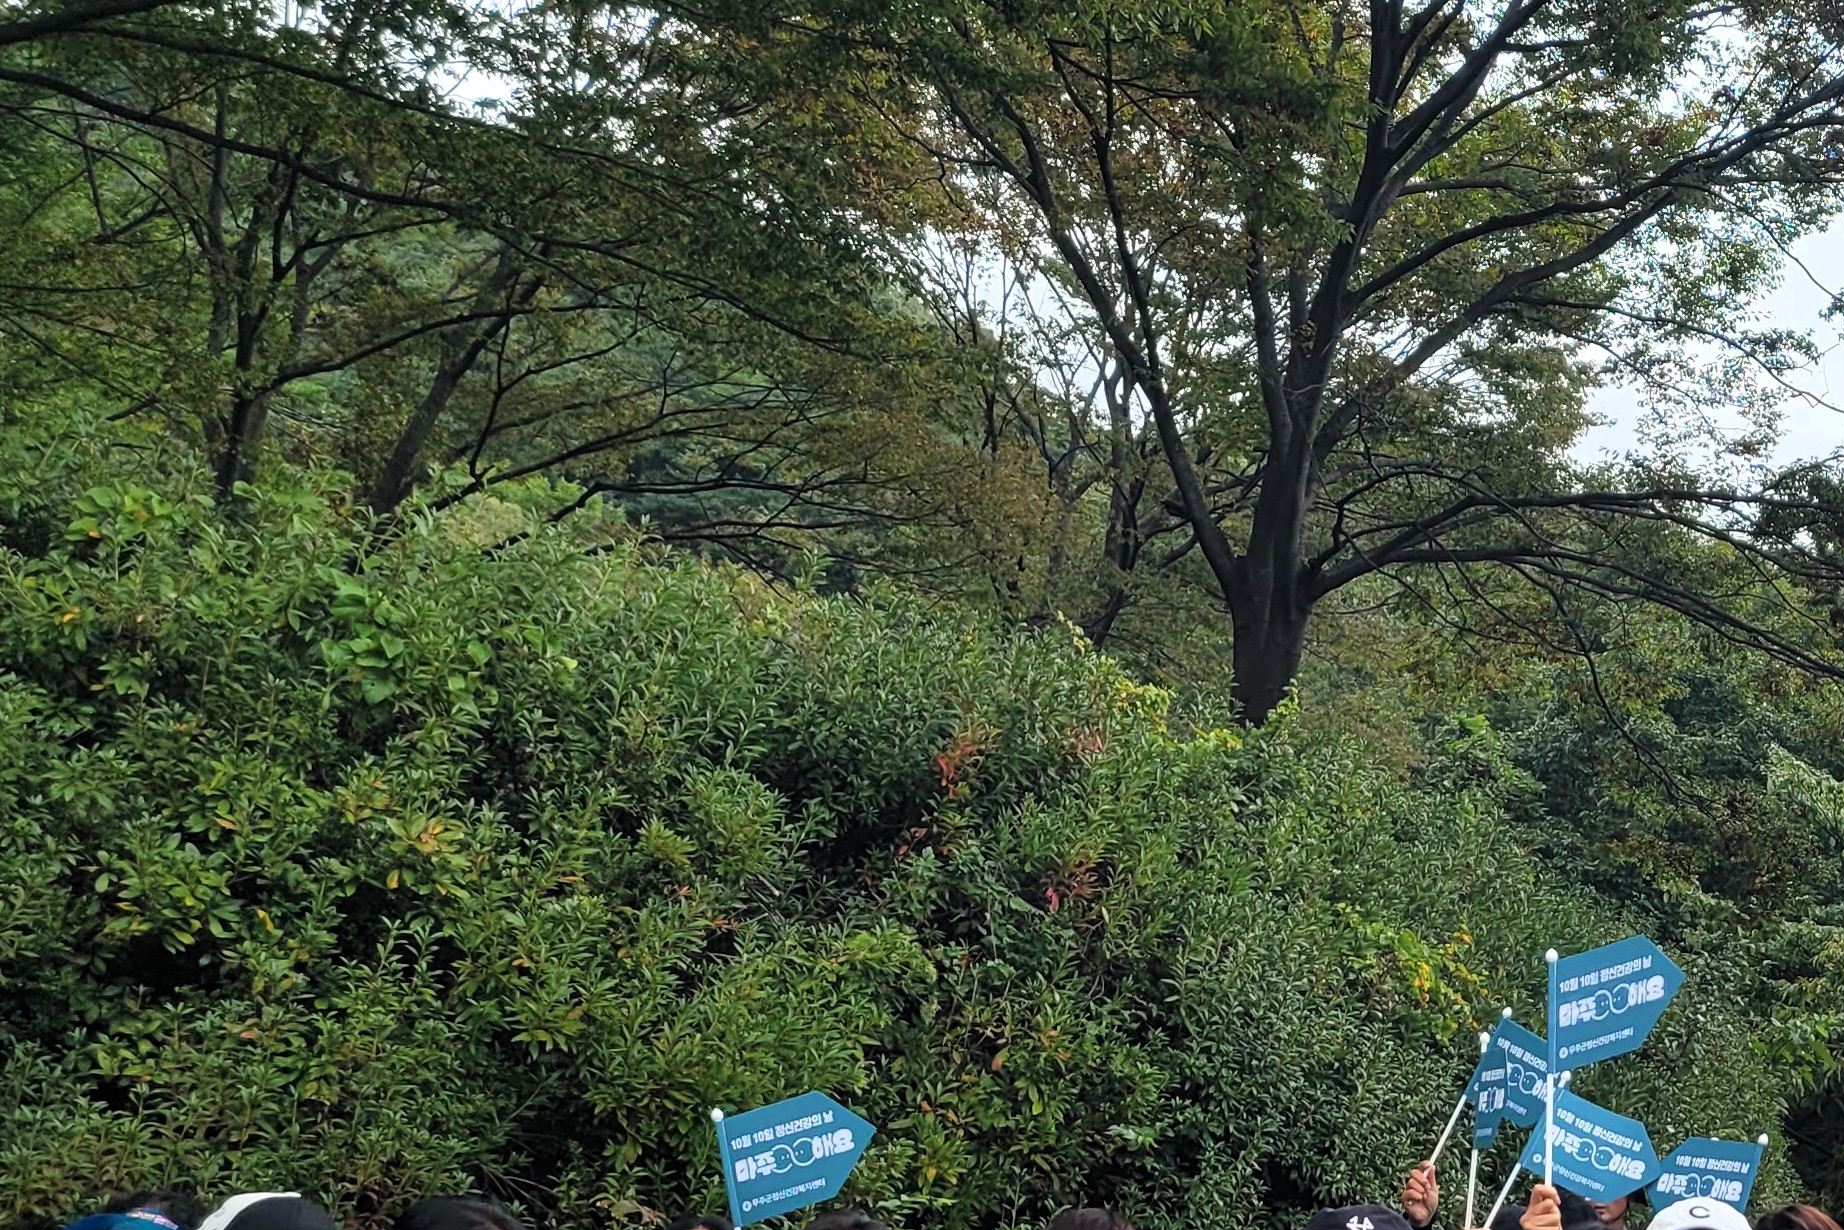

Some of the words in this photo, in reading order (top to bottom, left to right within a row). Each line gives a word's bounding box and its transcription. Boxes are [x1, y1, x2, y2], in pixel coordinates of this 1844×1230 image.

[1559, 977, 1578, 993] 10월
[1580, 972, 1598, 987] 10일
[1600, 958, 1641, 982] 정신건강의
[1643, 955, 1652, 969] 날
[730, 1134, 752, 1150] 10월
[753, 1129, 774, 1144] 10일
[775, 1113, 822, 1137] 정신건강의
[823, 1110, 834, 1124] 날
[1556, 1108, 1575, 1125] 10월
[1575, 1118, 1593, 1133] 10일
[1592, 1125, 1633, 1149] 정신건강의
[1632, 1140, 1642, 1152] 날
[1676, 1155, 1692, 1167] 10월
[1692, 1157, 1707, 1169] 10일
[1707, 1158, 1741, 1173] 정신건강의
[1741, 1163, 1750, 1174] 날
